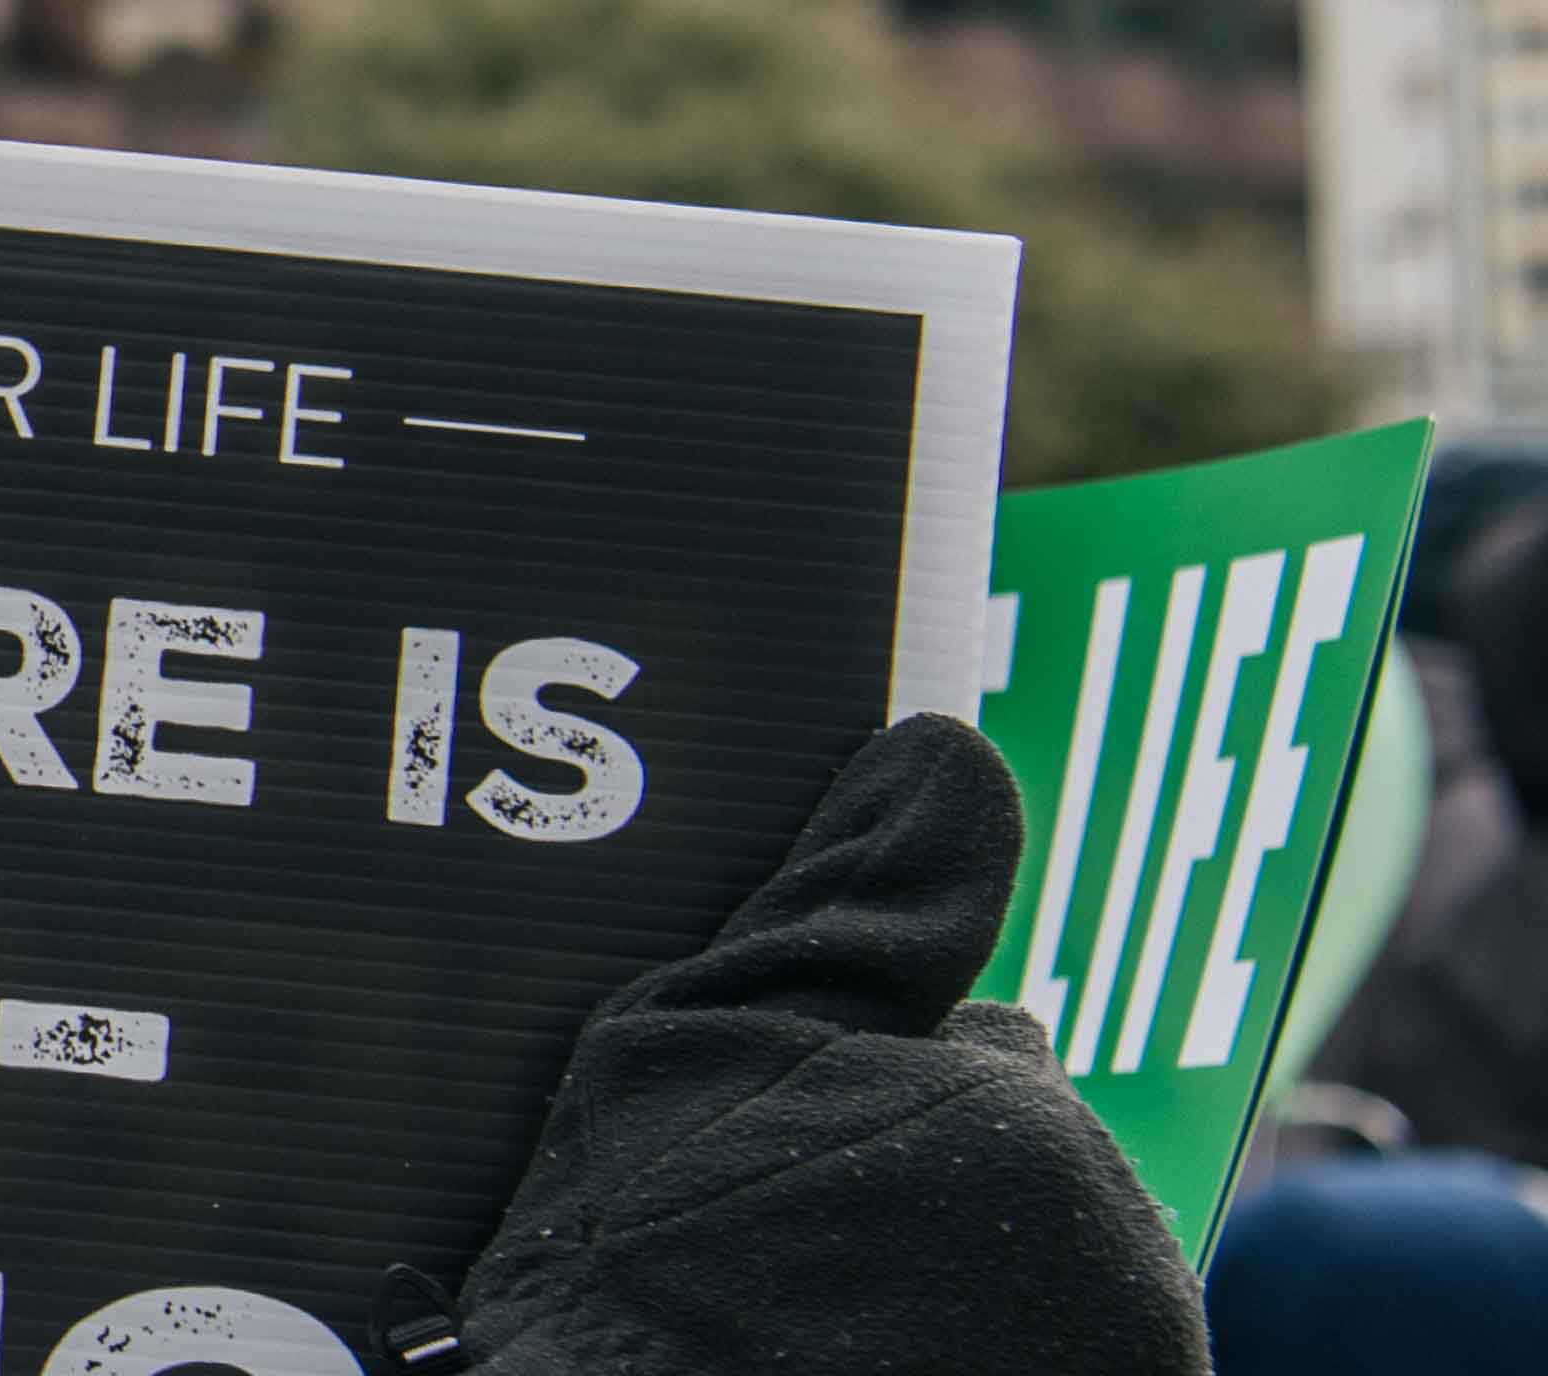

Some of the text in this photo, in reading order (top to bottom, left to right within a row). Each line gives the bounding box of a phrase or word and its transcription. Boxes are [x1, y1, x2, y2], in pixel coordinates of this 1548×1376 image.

[93, 344, 353, 469] LIFE
[388, 626, 645, 843] IS
[1018, 533, 1366, 1076] LIFE
